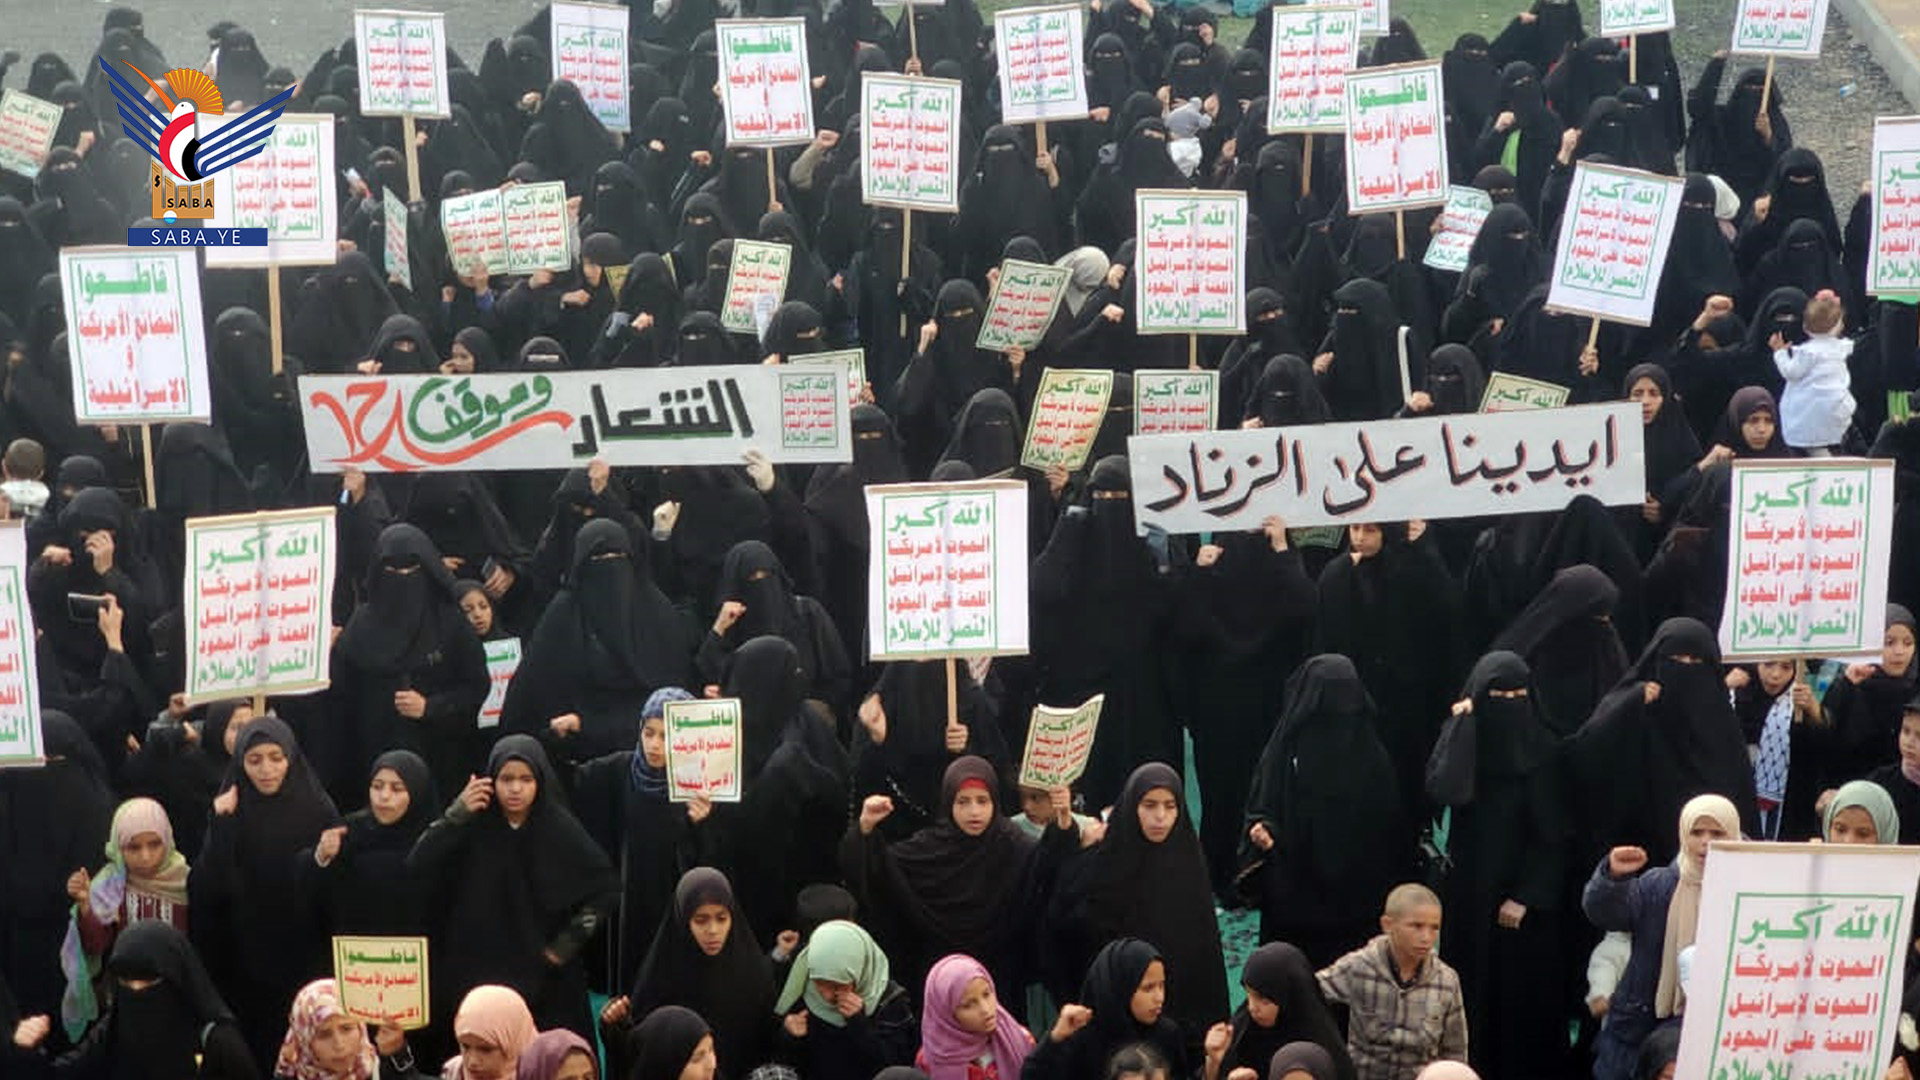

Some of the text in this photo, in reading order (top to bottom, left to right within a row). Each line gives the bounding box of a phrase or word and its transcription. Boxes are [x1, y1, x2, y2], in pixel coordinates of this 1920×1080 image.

[572, 378, 754, 458] الشعار
[1145, 433, 1308, 518] الزناد
[1820, 478, 1863, 506] الله
[953, 501, 990, 526] الله
[275, 530, 317, 556] الله
[1810, 519, 1862, 542] الموت
[946, 537, 991, 557] الموت
[947, 565, 991, 585] الموت
[1808, 552, 1859, 574] الموت
[266, 566, 317, 589] الموت
[266, 595, 315, 618] الموت
[889, 591, 991, 614] اللعنة على اليهود
[1740, 581, 1858, 606] اللعنة على اليهود
[198, 622, 314, 654] اللعنة على اليهود
[945, 614, 991, 644] النصر
[1801, 608, 1855, 642] النصر
[260, 647, 312, 681] النصر
[1835, 906, 1891, 939] الله
[1819, 955, 1885, 981] الموت
[1812, 994, 1879, 1019] الموت
[1721, 1026, 1874, 1055] اللعنة على اليهود
